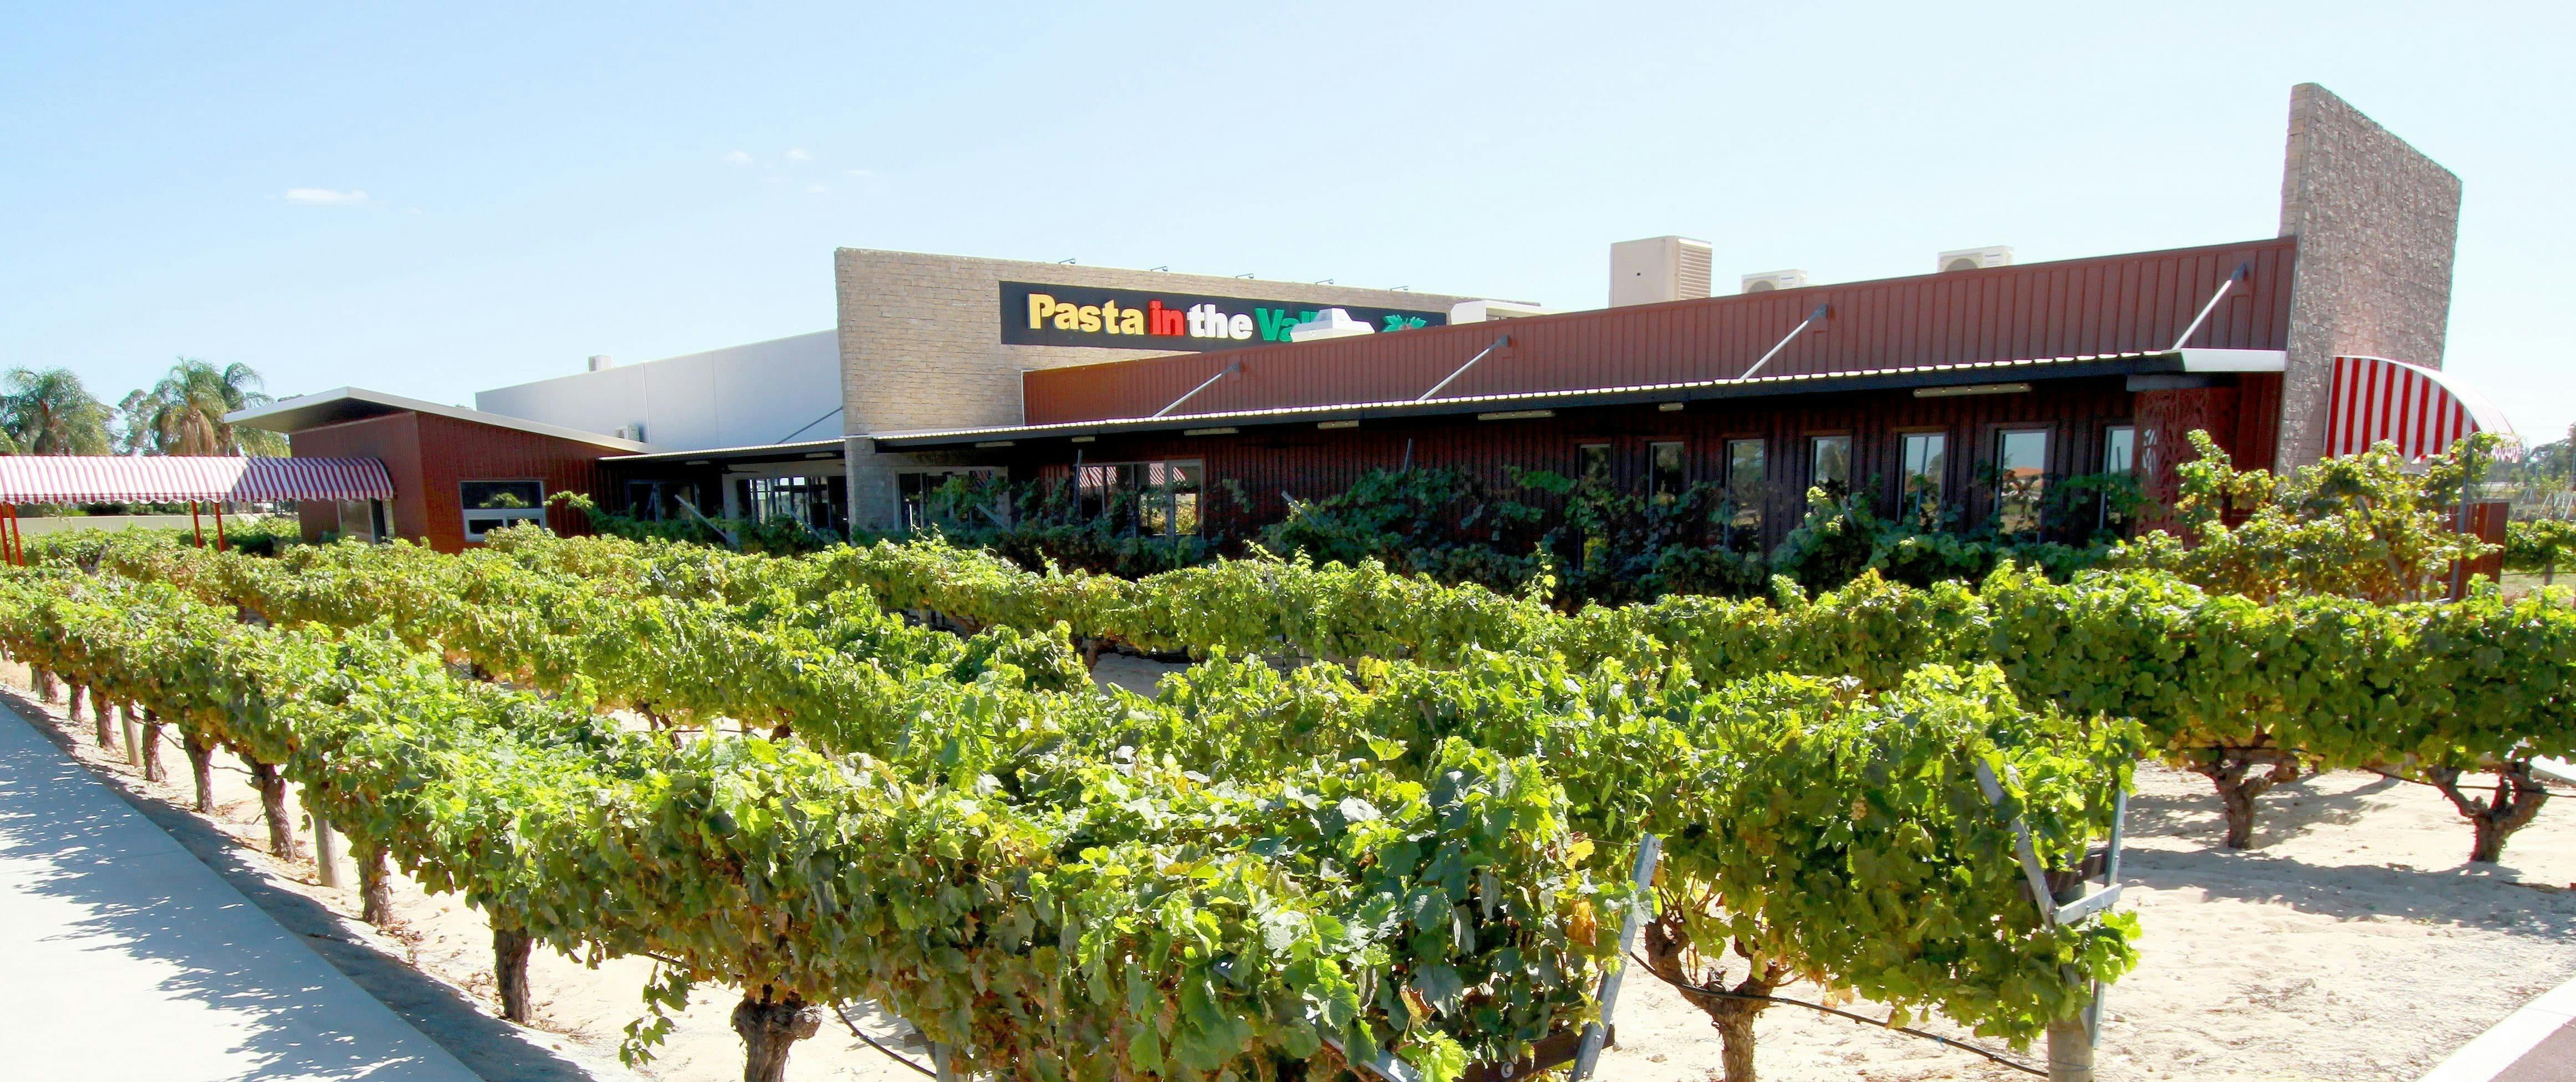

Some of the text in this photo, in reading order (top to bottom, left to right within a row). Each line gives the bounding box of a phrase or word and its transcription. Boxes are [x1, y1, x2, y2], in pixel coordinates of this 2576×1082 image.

[1027, 293, 1145, 335] Pasta
[1149, 299, 1185, 336] in
[1186, 303, 1254, 340] the
